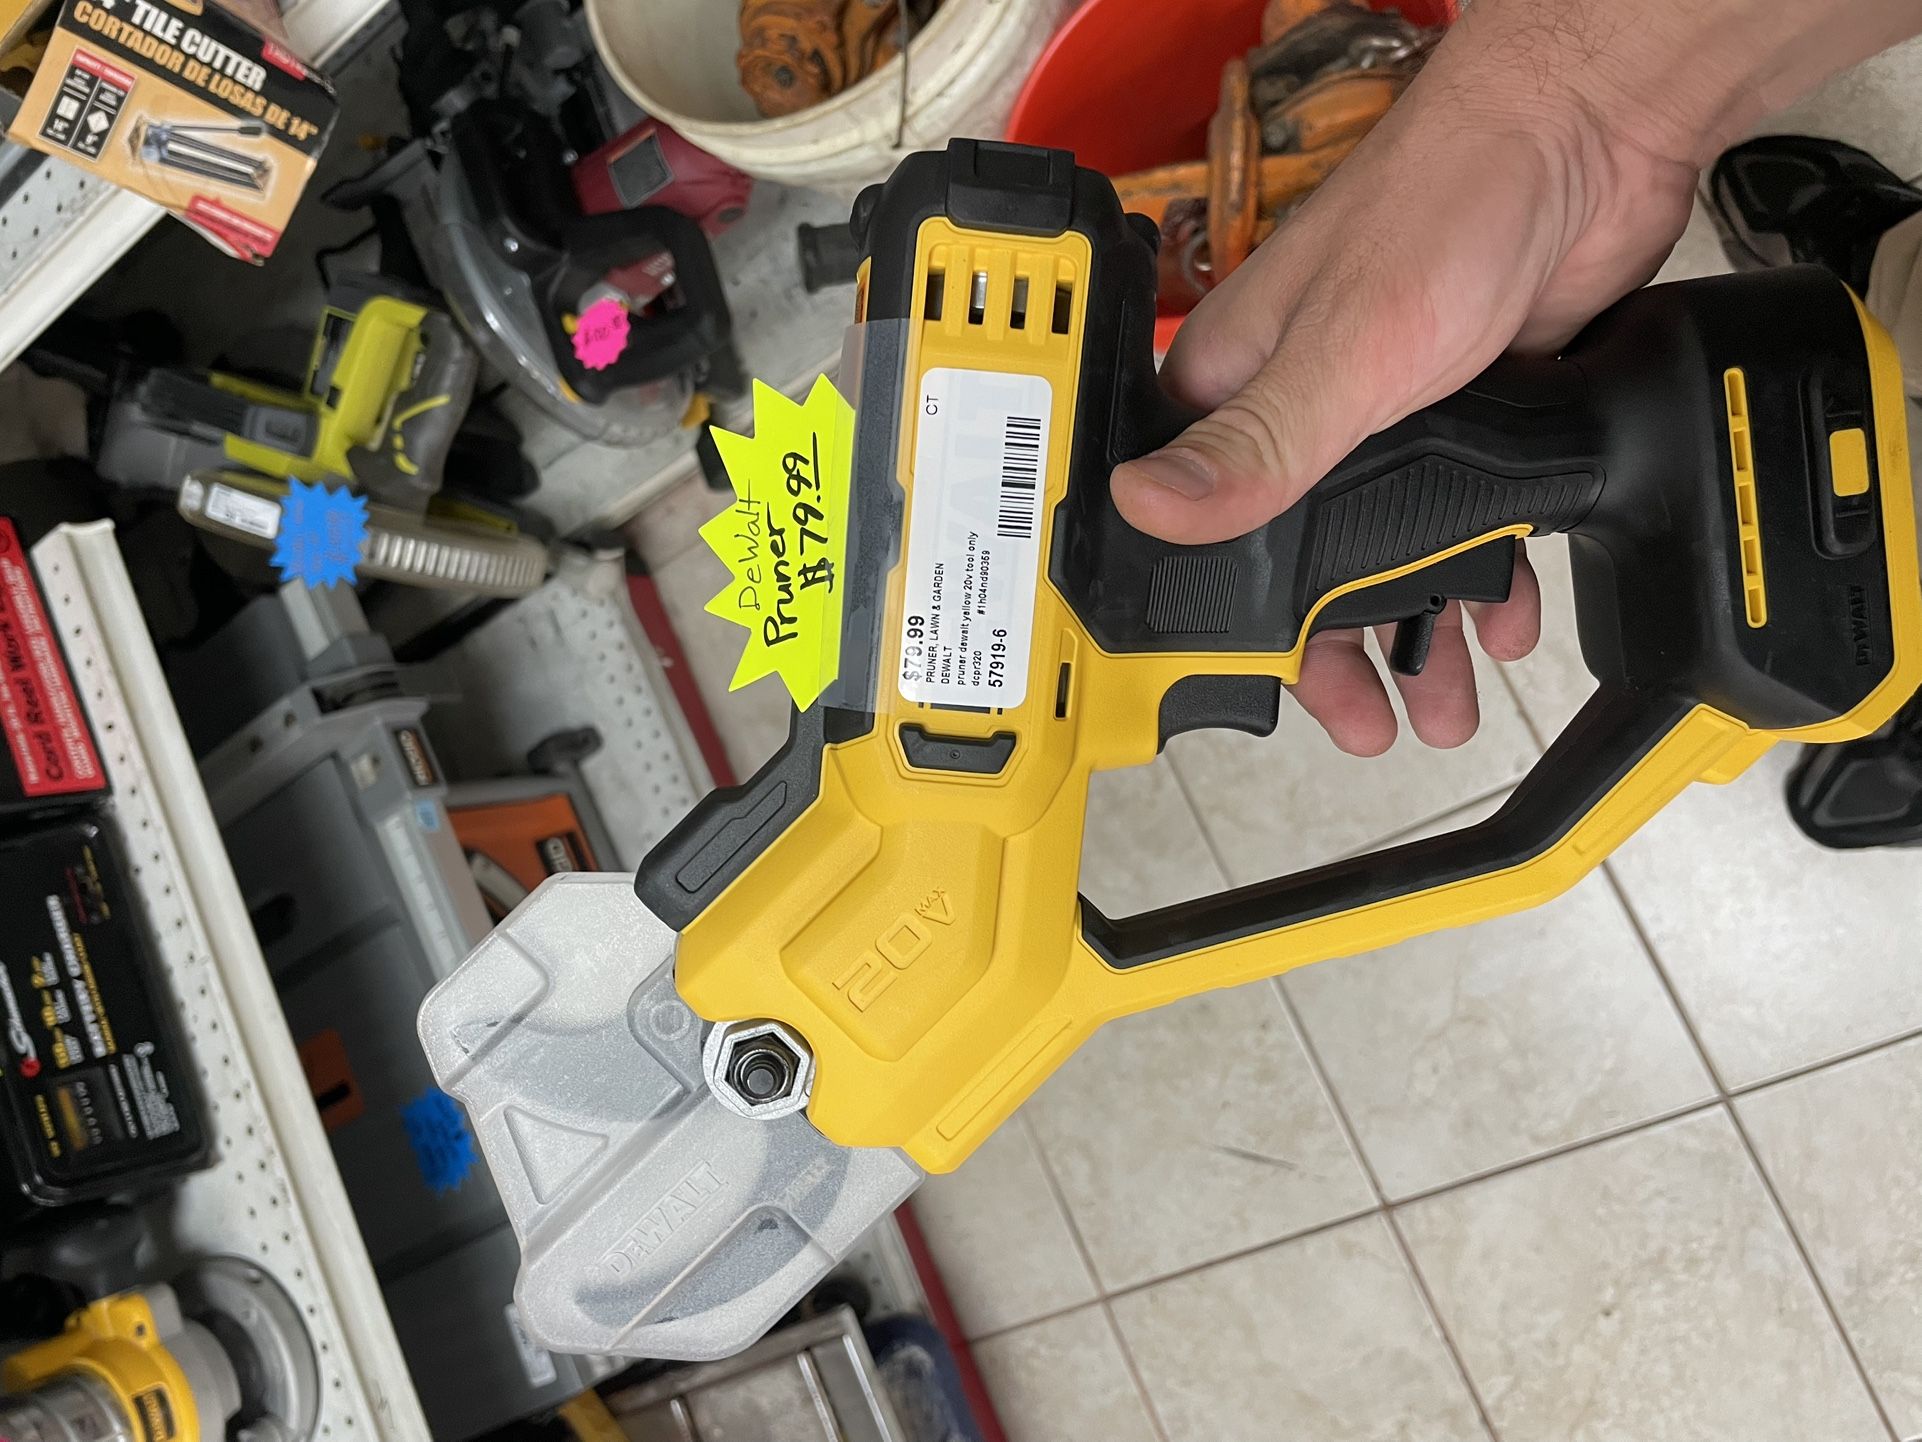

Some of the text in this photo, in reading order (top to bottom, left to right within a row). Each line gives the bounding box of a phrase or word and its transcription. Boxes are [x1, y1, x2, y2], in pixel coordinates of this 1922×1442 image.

[73, 0, 184, 73] CORTADOR
[181, 58, 209, 84] DE
[207, 74, 269, 119] LOSAS
[263, 102, 292, 128] DE
[288, 117, 319, 142] 14"
[131, 0, 184, 45] TILE
[180, 28, 268, 92] CUTTER
[926, 394, 938, 415] CT
[764, 502, 798, 647] Pruner
[782, 448, 834, 593] $79.99
[902, 615, 925, 681] $79.99
[926, 563, 944, 683] PRUNER, LAWN & GARDEN
[941, 646, 953, 684] DEWALT
[957, 531, 978, 686] pruner dewalt yellow 20v tool only
[988, 628, 1008, 688] 57919-6
[971, 650, 983, 686] dcpr320
[831, 892, 956, 1013] 20V
[604, 1158, 731, 1276] DEWALT
